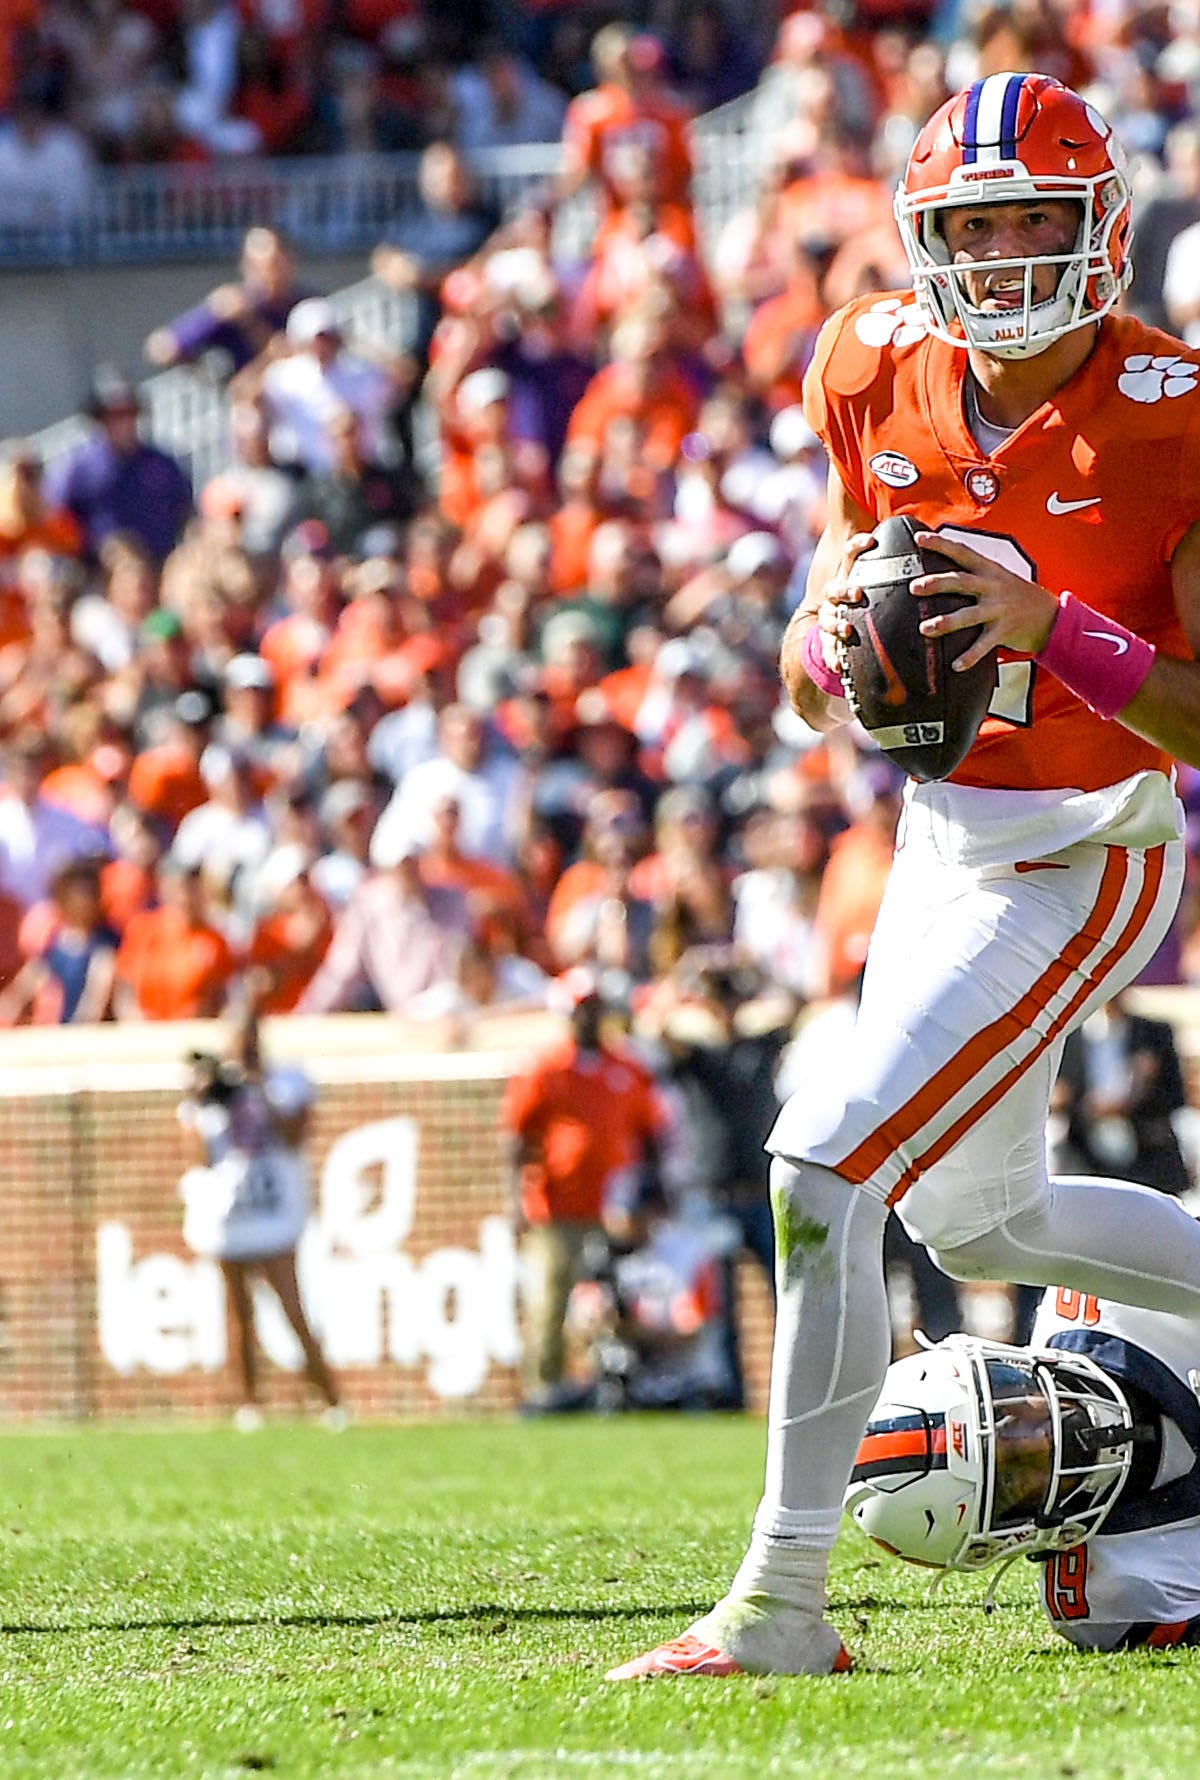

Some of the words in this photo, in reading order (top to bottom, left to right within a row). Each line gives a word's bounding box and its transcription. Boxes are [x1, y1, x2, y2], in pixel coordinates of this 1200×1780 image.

[878, 461, 912, 478] ACC
[950, 1421, 966, 1459] ACC
[1045, 1540, 1090, 1620] 19
